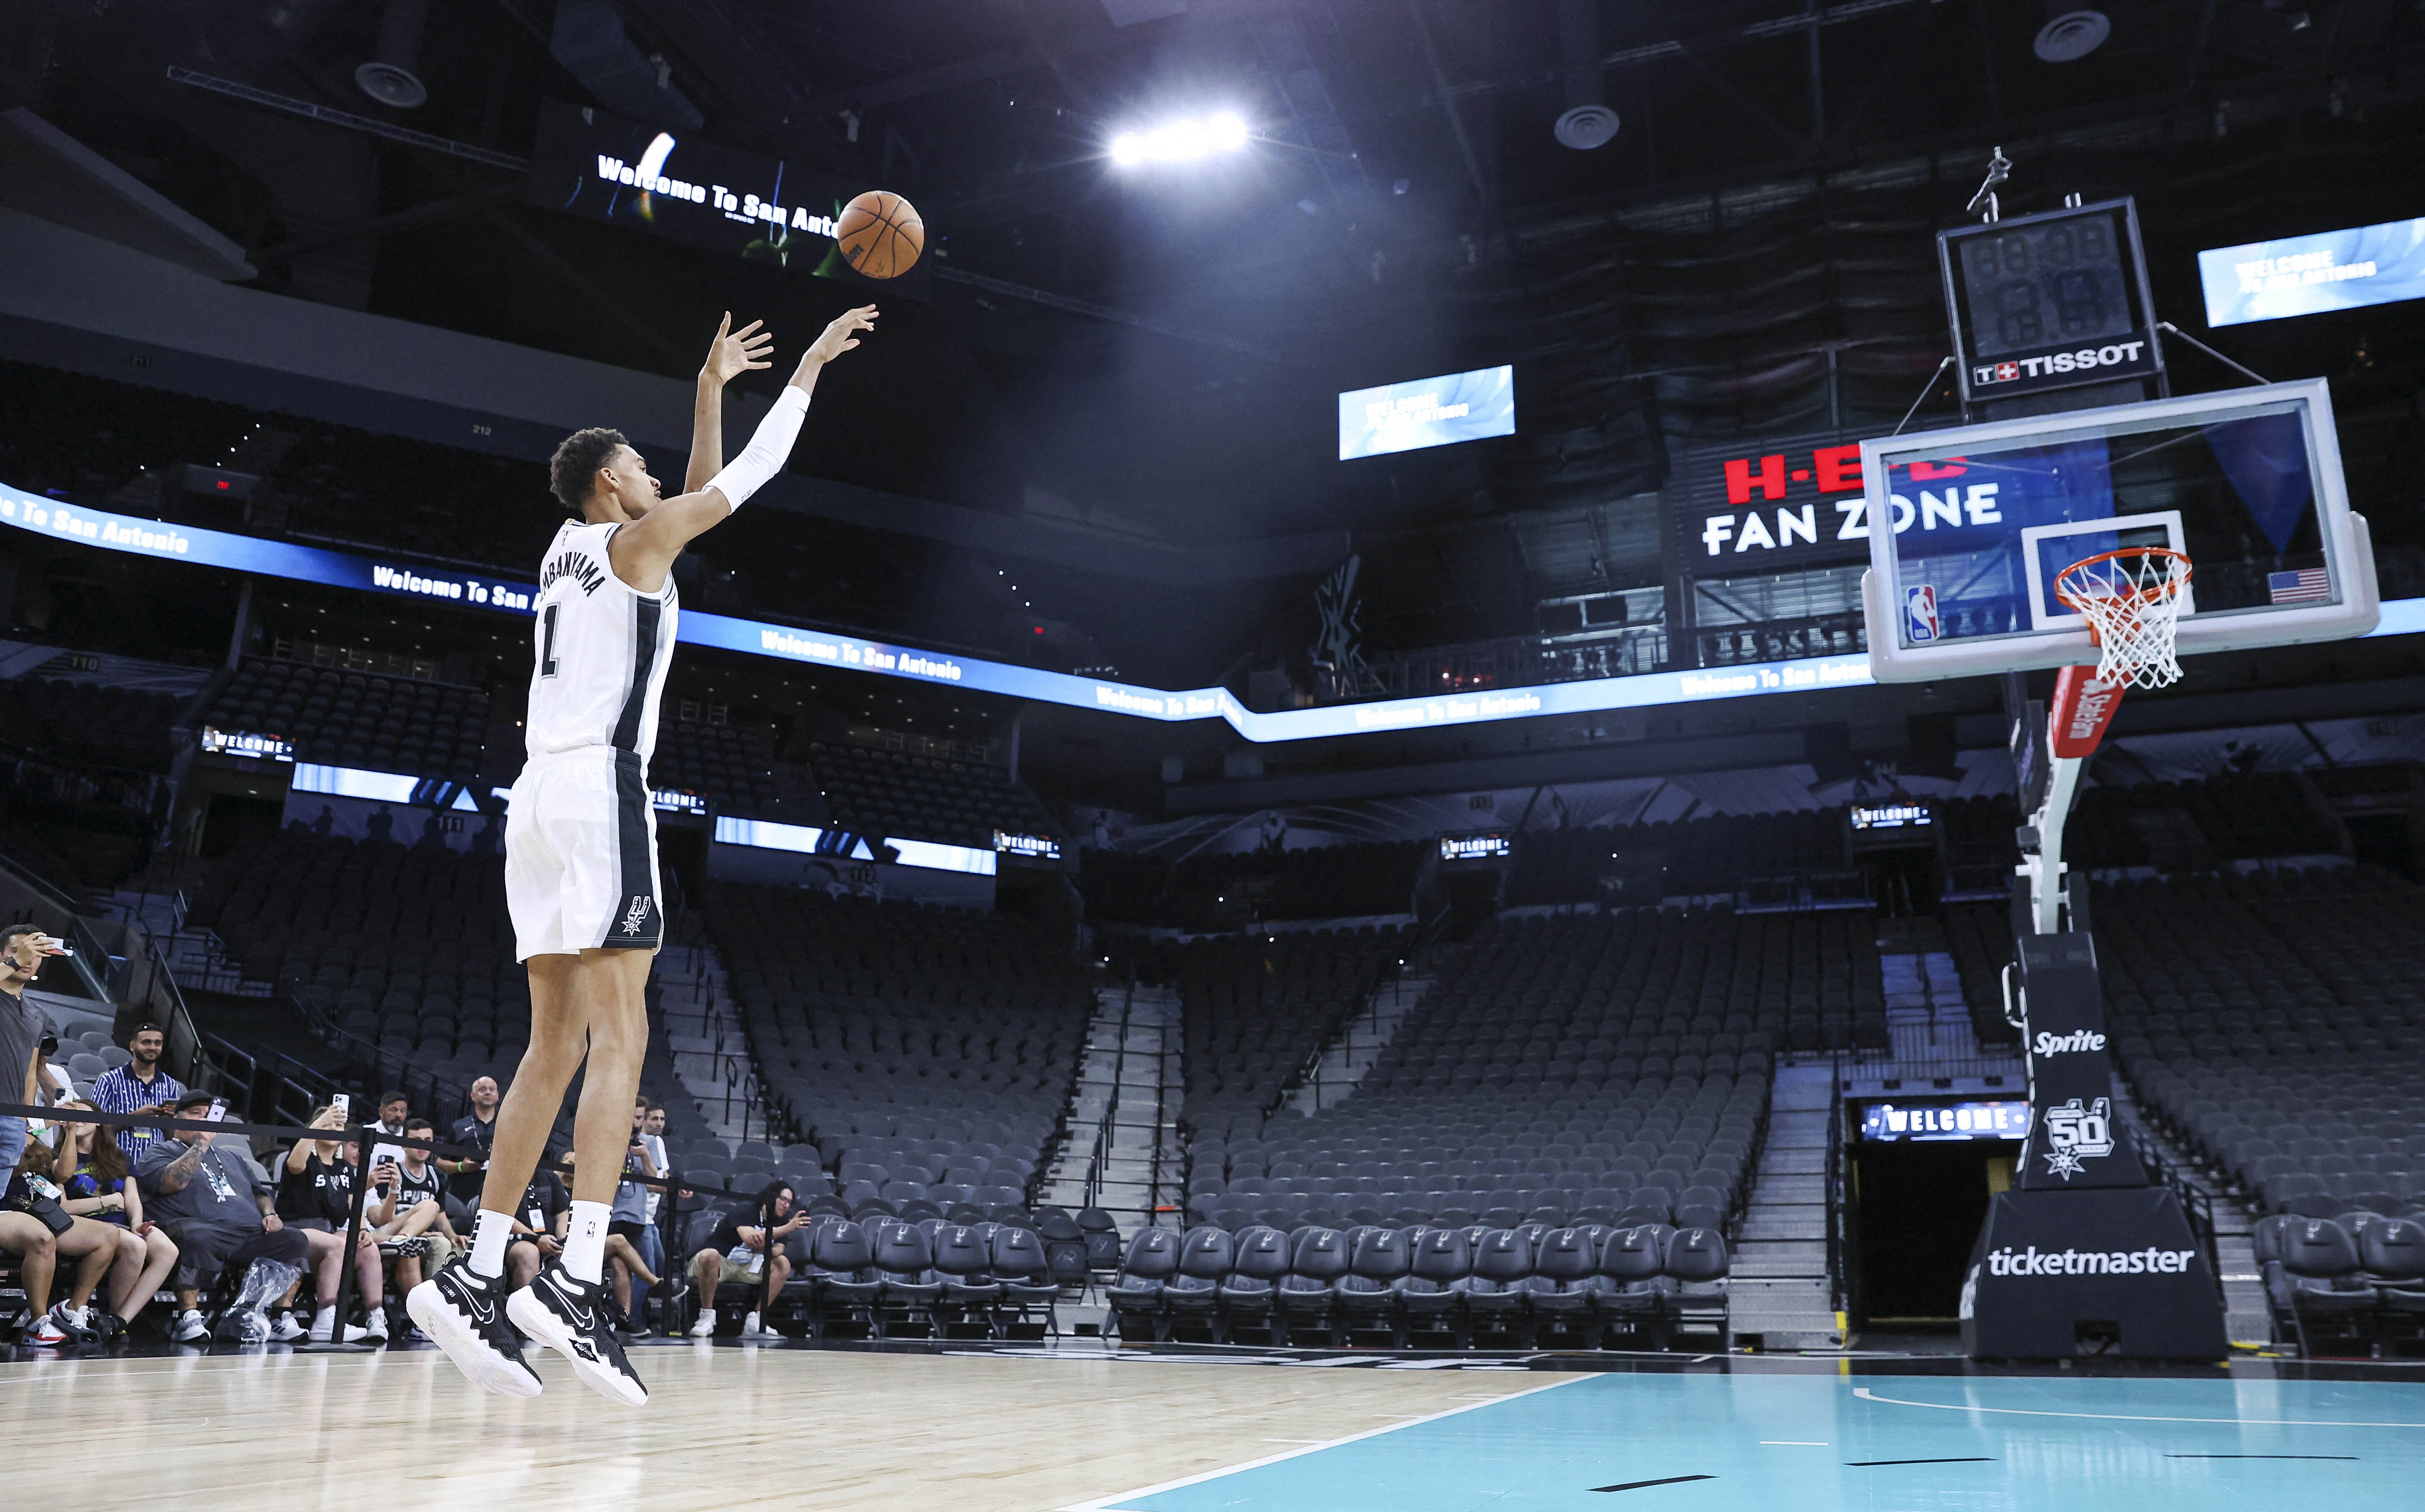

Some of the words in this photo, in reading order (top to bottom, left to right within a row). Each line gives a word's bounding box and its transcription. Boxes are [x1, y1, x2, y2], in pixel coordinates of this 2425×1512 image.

[598, 155, 706, 203] Welcome
[712, 185, 738, 211] To
[743, 194, 787, 225] San
[791, 207, 840, 239] Anto
[2235, 249, 2335, 281] WELCOME
[2019, 340, 2144, 378] TISSOT
[1364, 392, 1439, 418] WELCOME
[22, 499, 48, 526] To
[53, 510, 97, 538] San
[102, 521, 188, 554] Antonio
[1702, 504, 1817, 556] FAN
[1835, 482, 2003, 541] ZONE
[374, 566, 461, 598] Welcome
[467, 581, 488, 603] To
[492, 585, 529, 609] San
[540, 551, 606, 602] MBANYAMA
[761, 630, 838, 660] Welcome
[842, 643, 860, 664] To
[863, 647, 895, 669] San
[898, 653, 962, 680] Antonio
[1681, 675, 1756, 696] Welcome
[1759, 669, 1780, 688] To
[1782, 667, 1816, 686] San
[1819, 663, 1870, 682] Anton
[1096, 686, 1163, 714] Welcome
[1165, 697, 1184, 715] To
[1186, 696, 1215, 714] San
[1426, 703, 1444, 721] To
[1447, 700, 1478, 718] San
[1479, 693, 1541, 715] Antonio
[214, 734, 284, 753] WELCOME
[650, 791, 697, 807] ELCOME
[1860, 806, 1920, 822] WELCOME
[1001, 835, 1052, 852] WELCOME
[1450, 839, 1502, 853] WELCOME
[2033, 1029, 2107, 1058] Sprite
[1887, 1108, 2009, 1132] WELCOME
[2052, 1116, 2107, 1148] 50
[1988, 1246, 2195, 1276] ticketmaster
